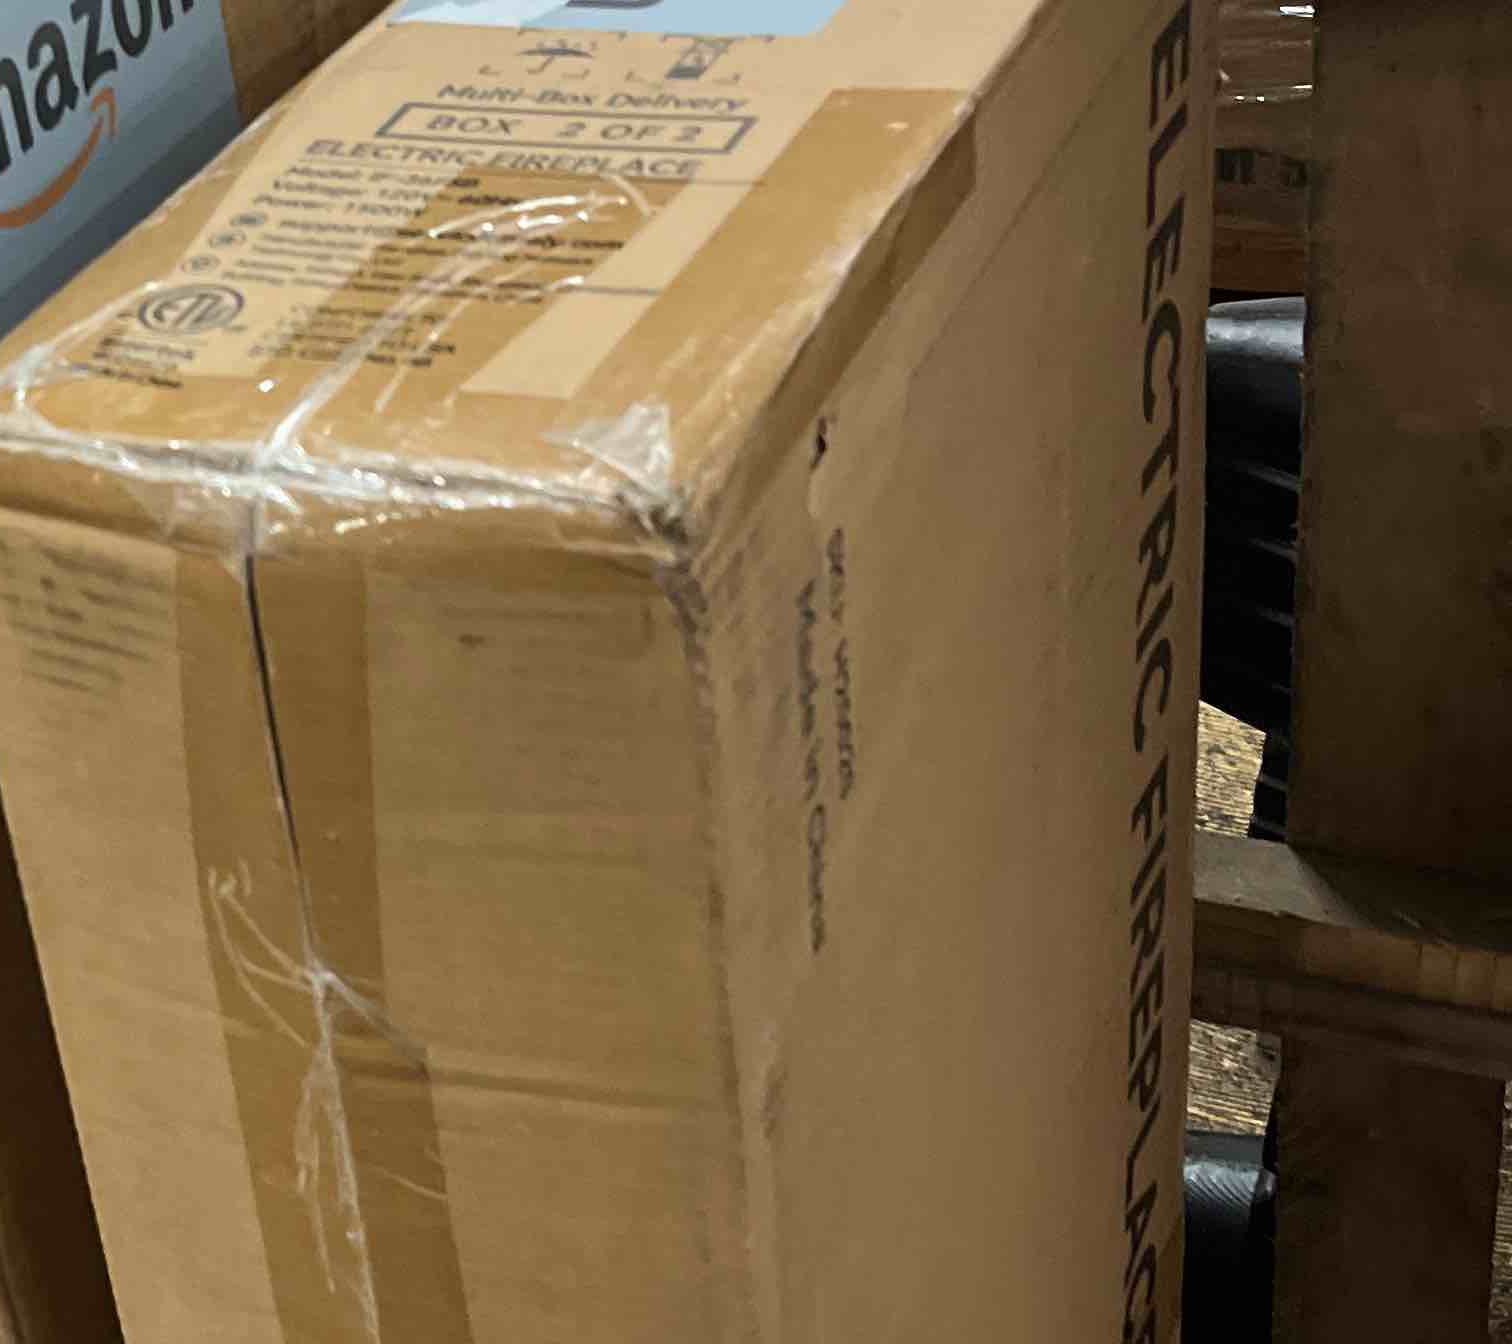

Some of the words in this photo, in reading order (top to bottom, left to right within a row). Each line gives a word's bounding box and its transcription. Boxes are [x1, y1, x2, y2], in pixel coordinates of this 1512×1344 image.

[437, 83, 597, 108] Multi-Box
[606, 90, 750, 113] Delivery
[425, 115, 523, 137] BOX
[557, 122, 587, 139] 2
[600, 122, 665, 142] OF
[305, 139, 483, 170] ELECTRIC
[490, 150, 706, 179] FIREPLACE
